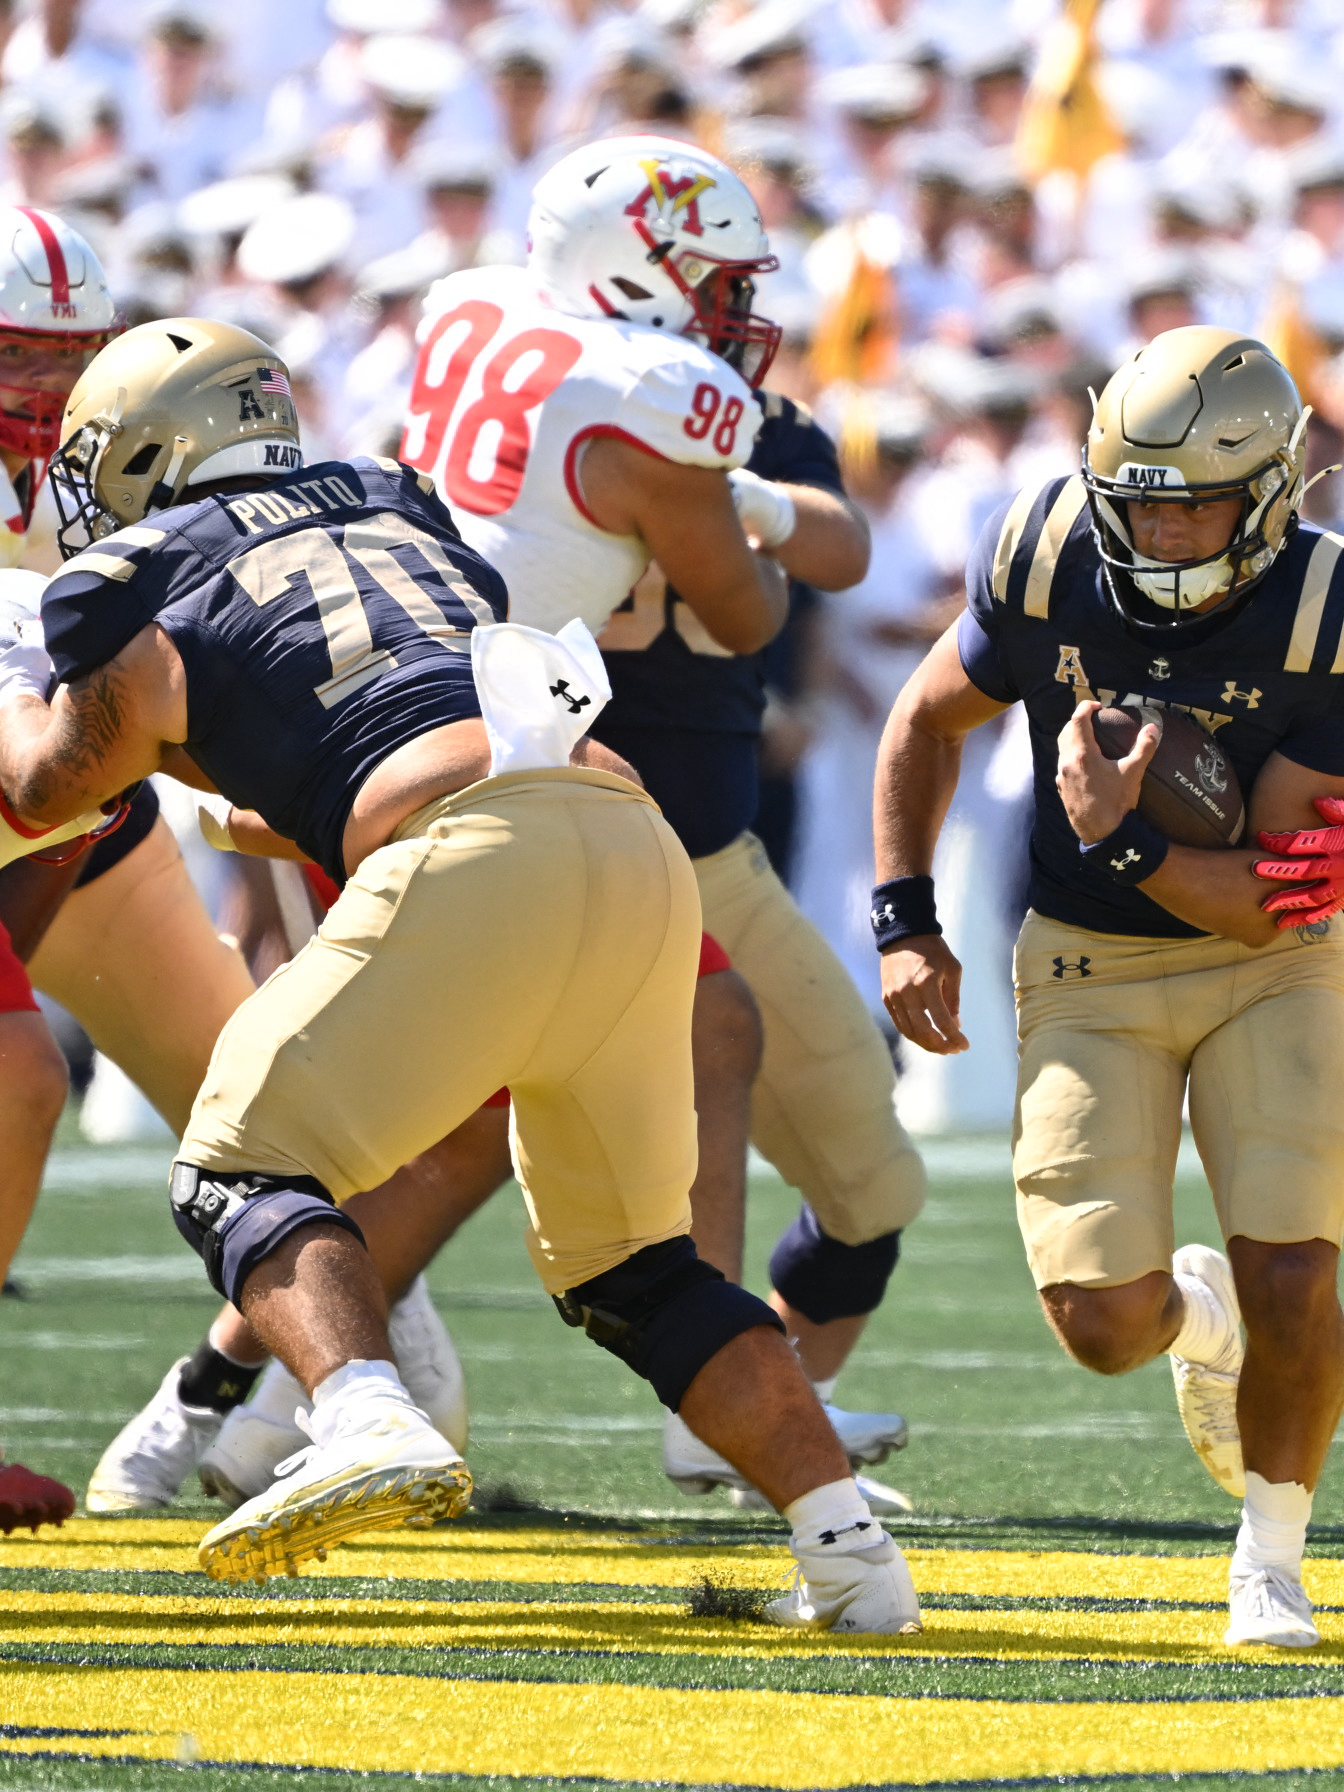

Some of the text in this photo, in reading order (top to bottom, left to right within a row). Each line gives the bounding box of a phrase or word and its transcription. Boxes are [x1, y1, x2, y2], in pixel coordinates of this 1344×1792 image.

[401, 300, 583, 516] 98
[683, 382, 744, 456] 98
[224, 476, 363, 534] POLITO
[1128, 467, 1167, 486] NAVY
[226, 512, 496, 710] 70
[1174, 771, 1226, 820] TEAM ISSUE
